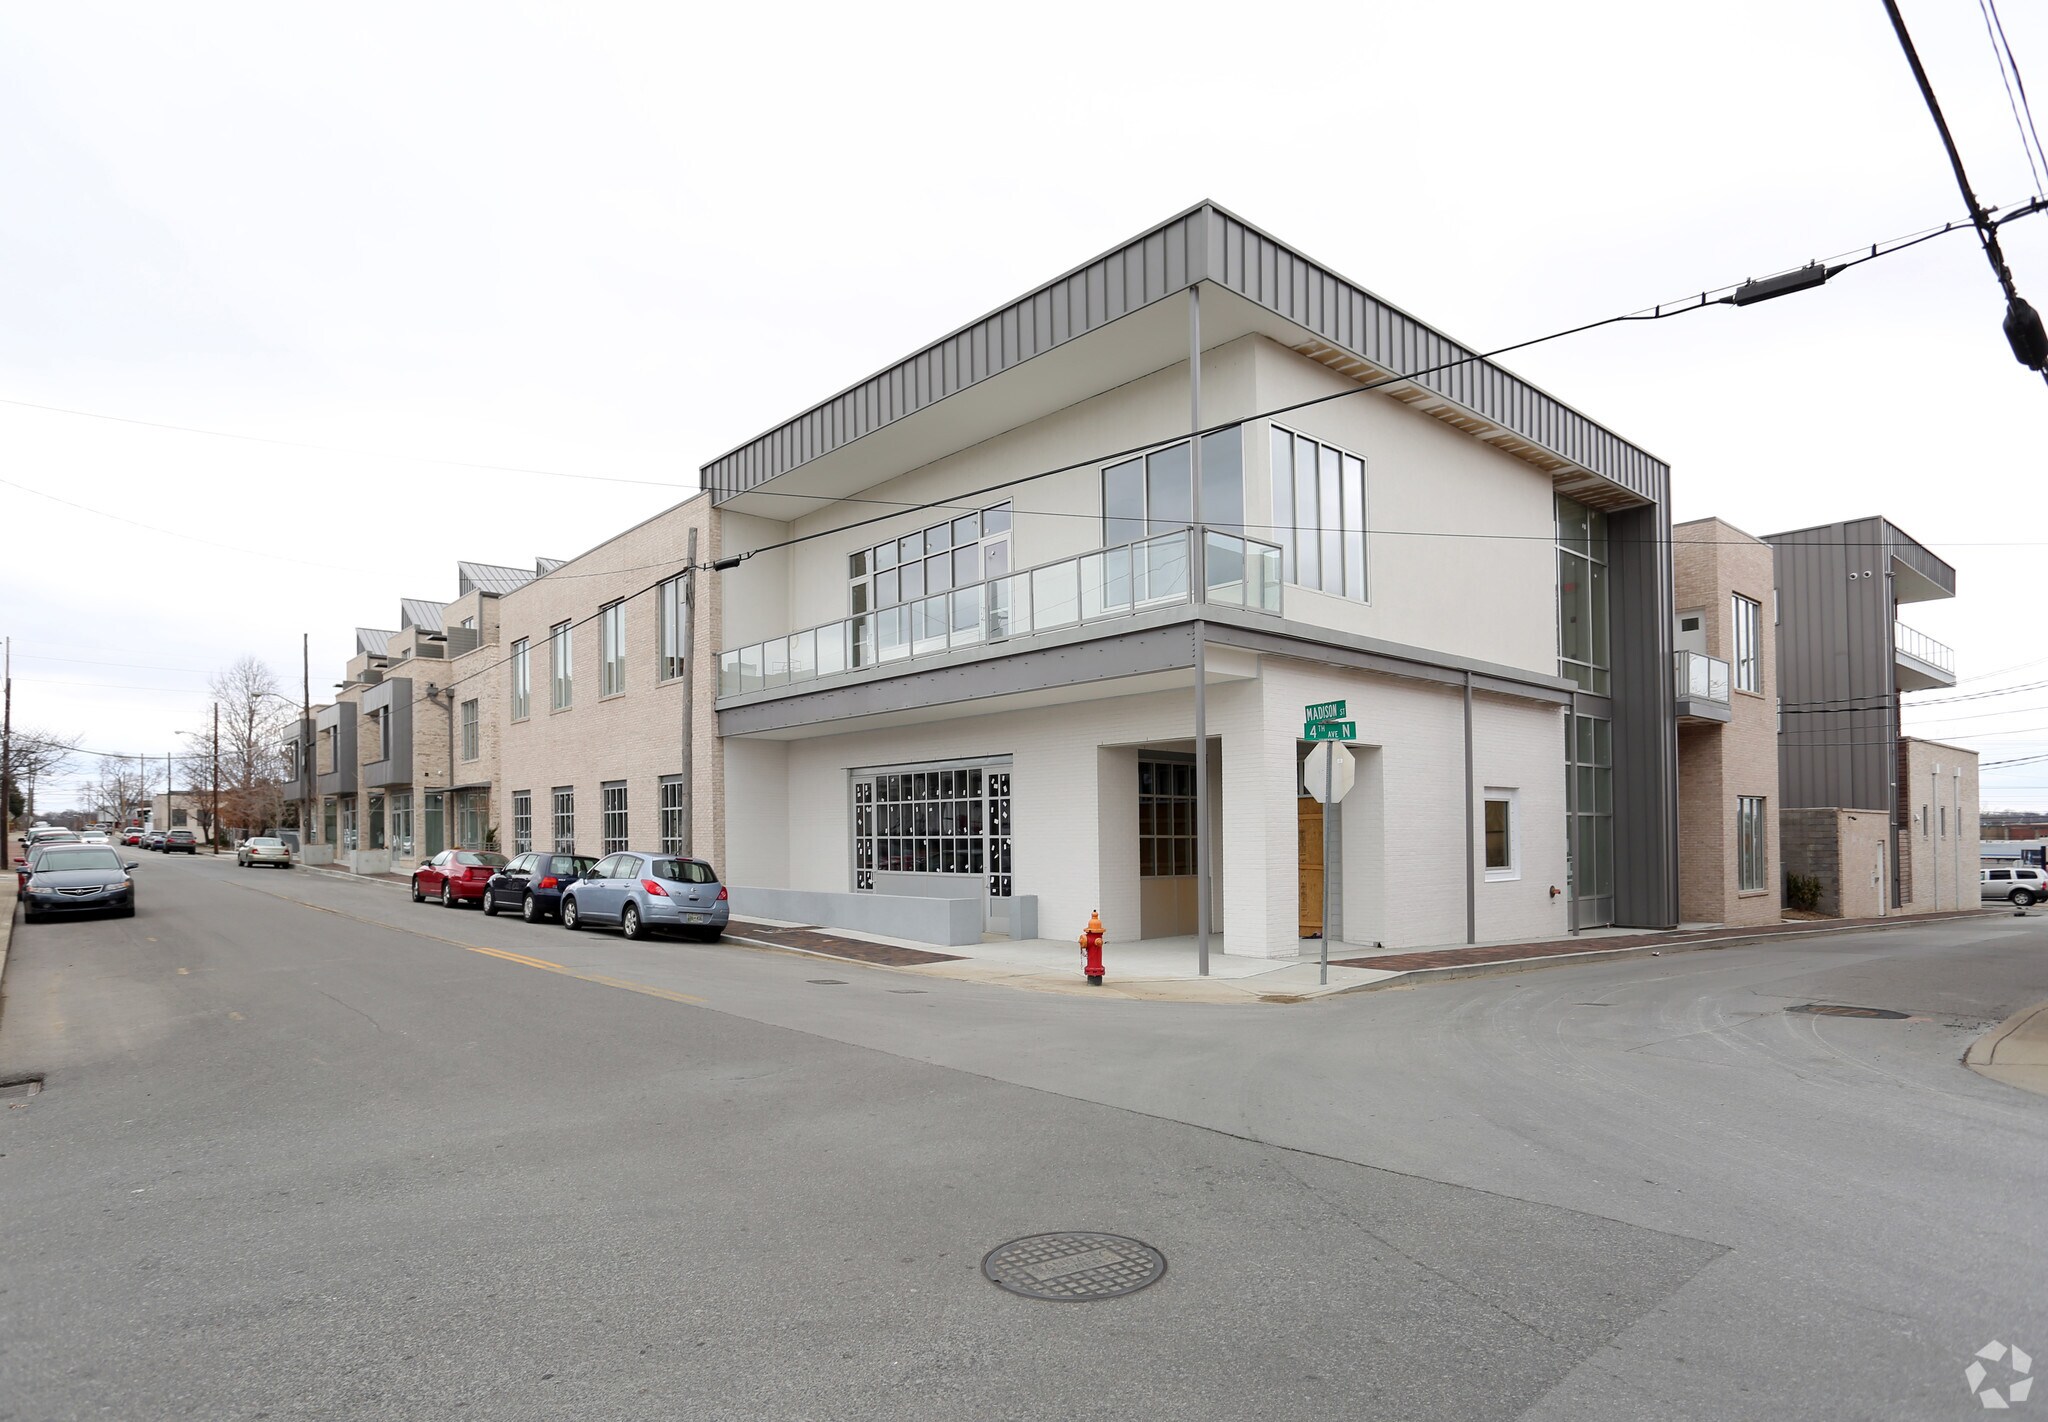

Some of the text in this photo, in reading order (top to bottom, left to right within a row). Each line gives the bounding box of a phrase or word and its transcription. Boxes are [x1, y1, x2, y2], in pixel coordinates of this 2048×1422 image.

[1306, 704, 1345, 722] MADISON ST
[1309, 724, 1350, 738] 4TH AVE N
